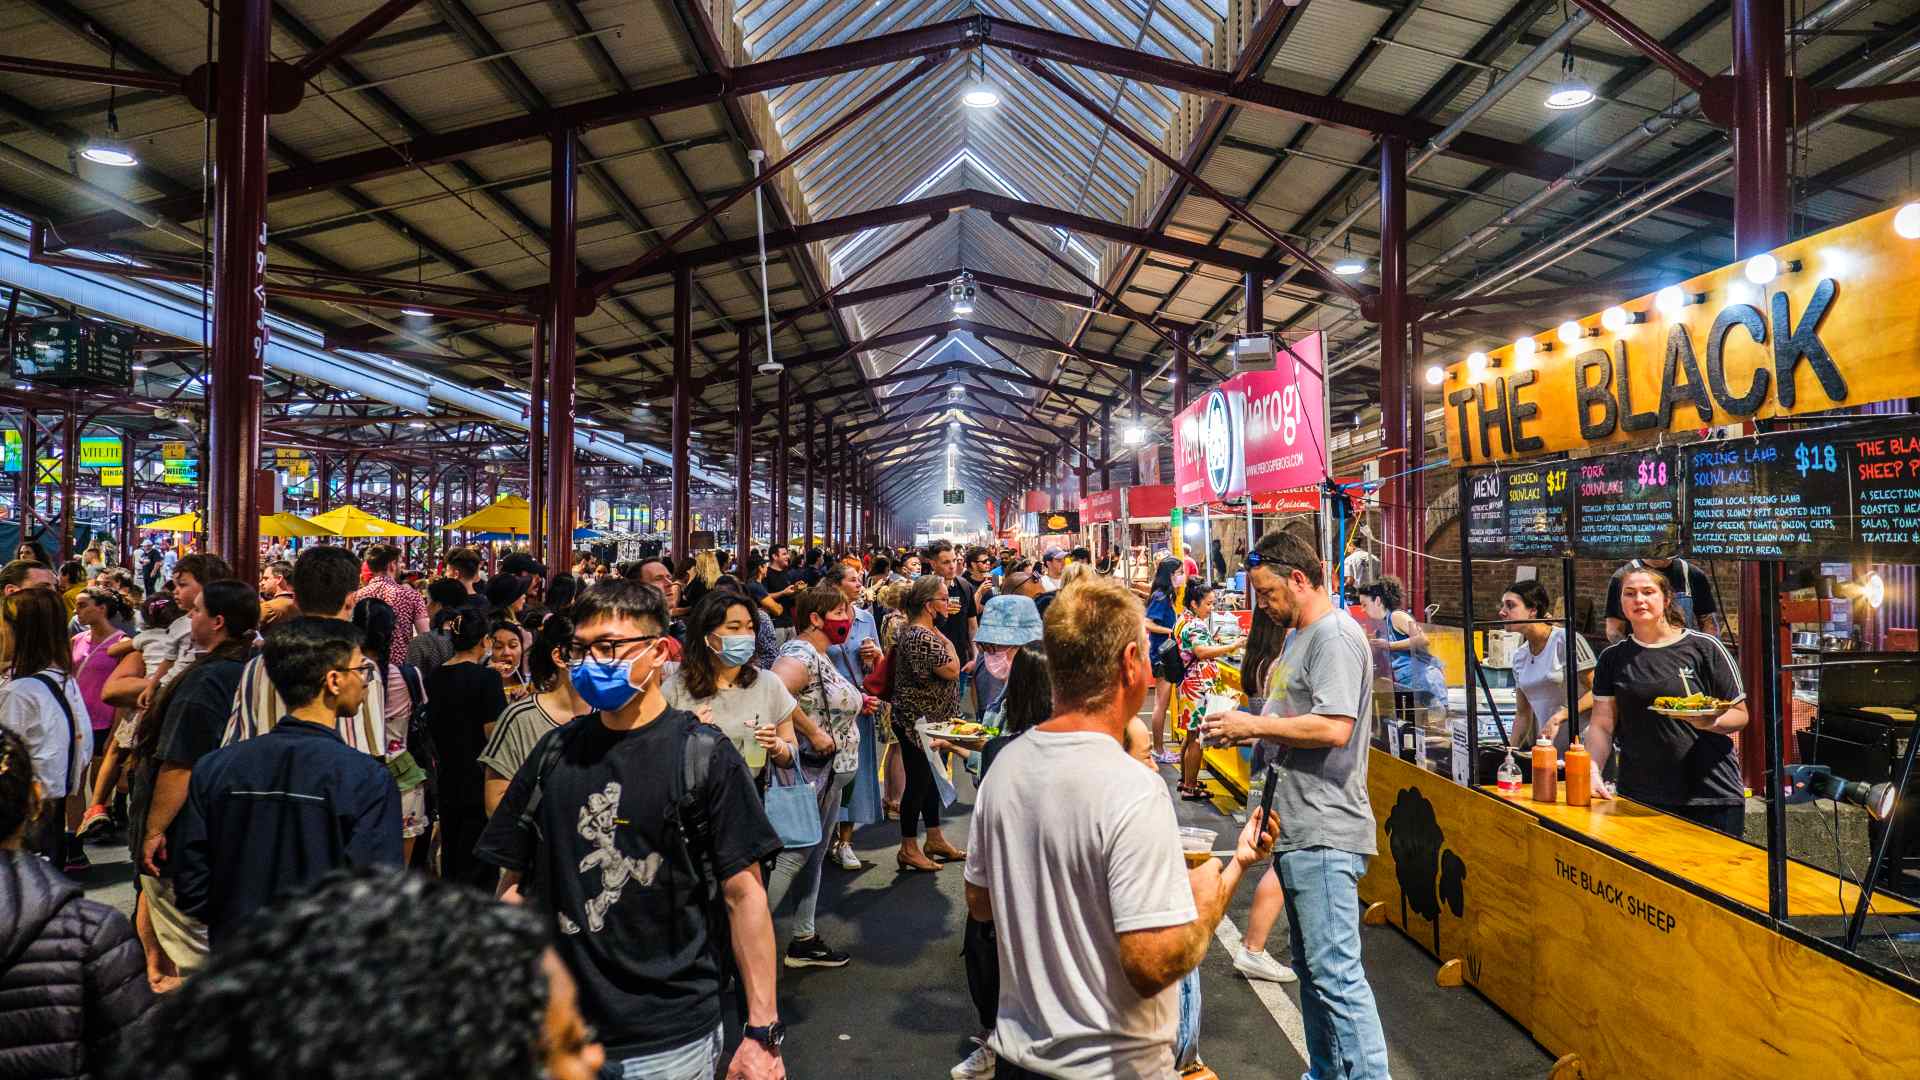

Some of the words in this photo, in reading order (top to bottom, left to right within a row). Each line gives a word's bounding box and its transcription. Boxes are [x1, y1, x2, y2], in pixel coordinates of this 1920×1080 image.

[1449, 369, 1545, 462] THE
[1575, 278, 1848, 440] BLACK
[1856, 440, 1885, 457] THE
[1890, 437, 1920, 454] BLA
[1694, 450, 1739, 467] SPRING
[1745, 447, 1777, 463] LAMB
[1795, 442, 1838, 478] $18
[1580, 464, 1606, 478] PORK
[1638, 460, 1667, 490] $18
[1695, 469, 1751, 486] SOUVLAKI
[1858, 460, 1904, 481] SHEEP
[1474, 476, 1499, 500] MENU
[1509, 472, 1539, 485] CHICKEN
[1546, 470, 1567, 496] $17
[1581, 480, 1624, 496] SOUVLAKI
[1509, 488, 1541, 503] SOUVLAKI
[1725, 496, 1746, 505] LOCAL
[1749, 495, 1777, 504] SPRING
[1780, 494, 1800, 503] LAMB
[1860, 491, 1867, 500] A
[1869, 489, 1920, 500] SELECTION
[1726, 508, 1752, 517] SLOWLY
[1754, 507, 1771, 517] SPIT
[1774, 506, 1807, 516] ROASTED
[1810, 505, 1831, 515] WITH
[1860, 504, 1900, 514] ROASTED
[1692, 521, 1714, 530] LEAFY
[1810, 519, 1836, 531] CHIPS,
[1860, 518, 1890, 529] SALAD,
[1729, 533, 1751, 542] FRESH
[1753, 533, 1778, 542] LEMON
[1779, 533, 1795, 542] AND
[1798, 532, 1812, 542] ALL
[1862, 532, 1908, 543] TZATZIKI
[1692, 545, 1723, 554] WRAPPED
[1725, 545, 1734, 554] IN
[1736, 545, 1753, 555] PITA
[1555, 857, 1577, 886] THE
[1580, 872, 1624, 908] BLACK
[1628, 896, 1676, 934] SHEEP
